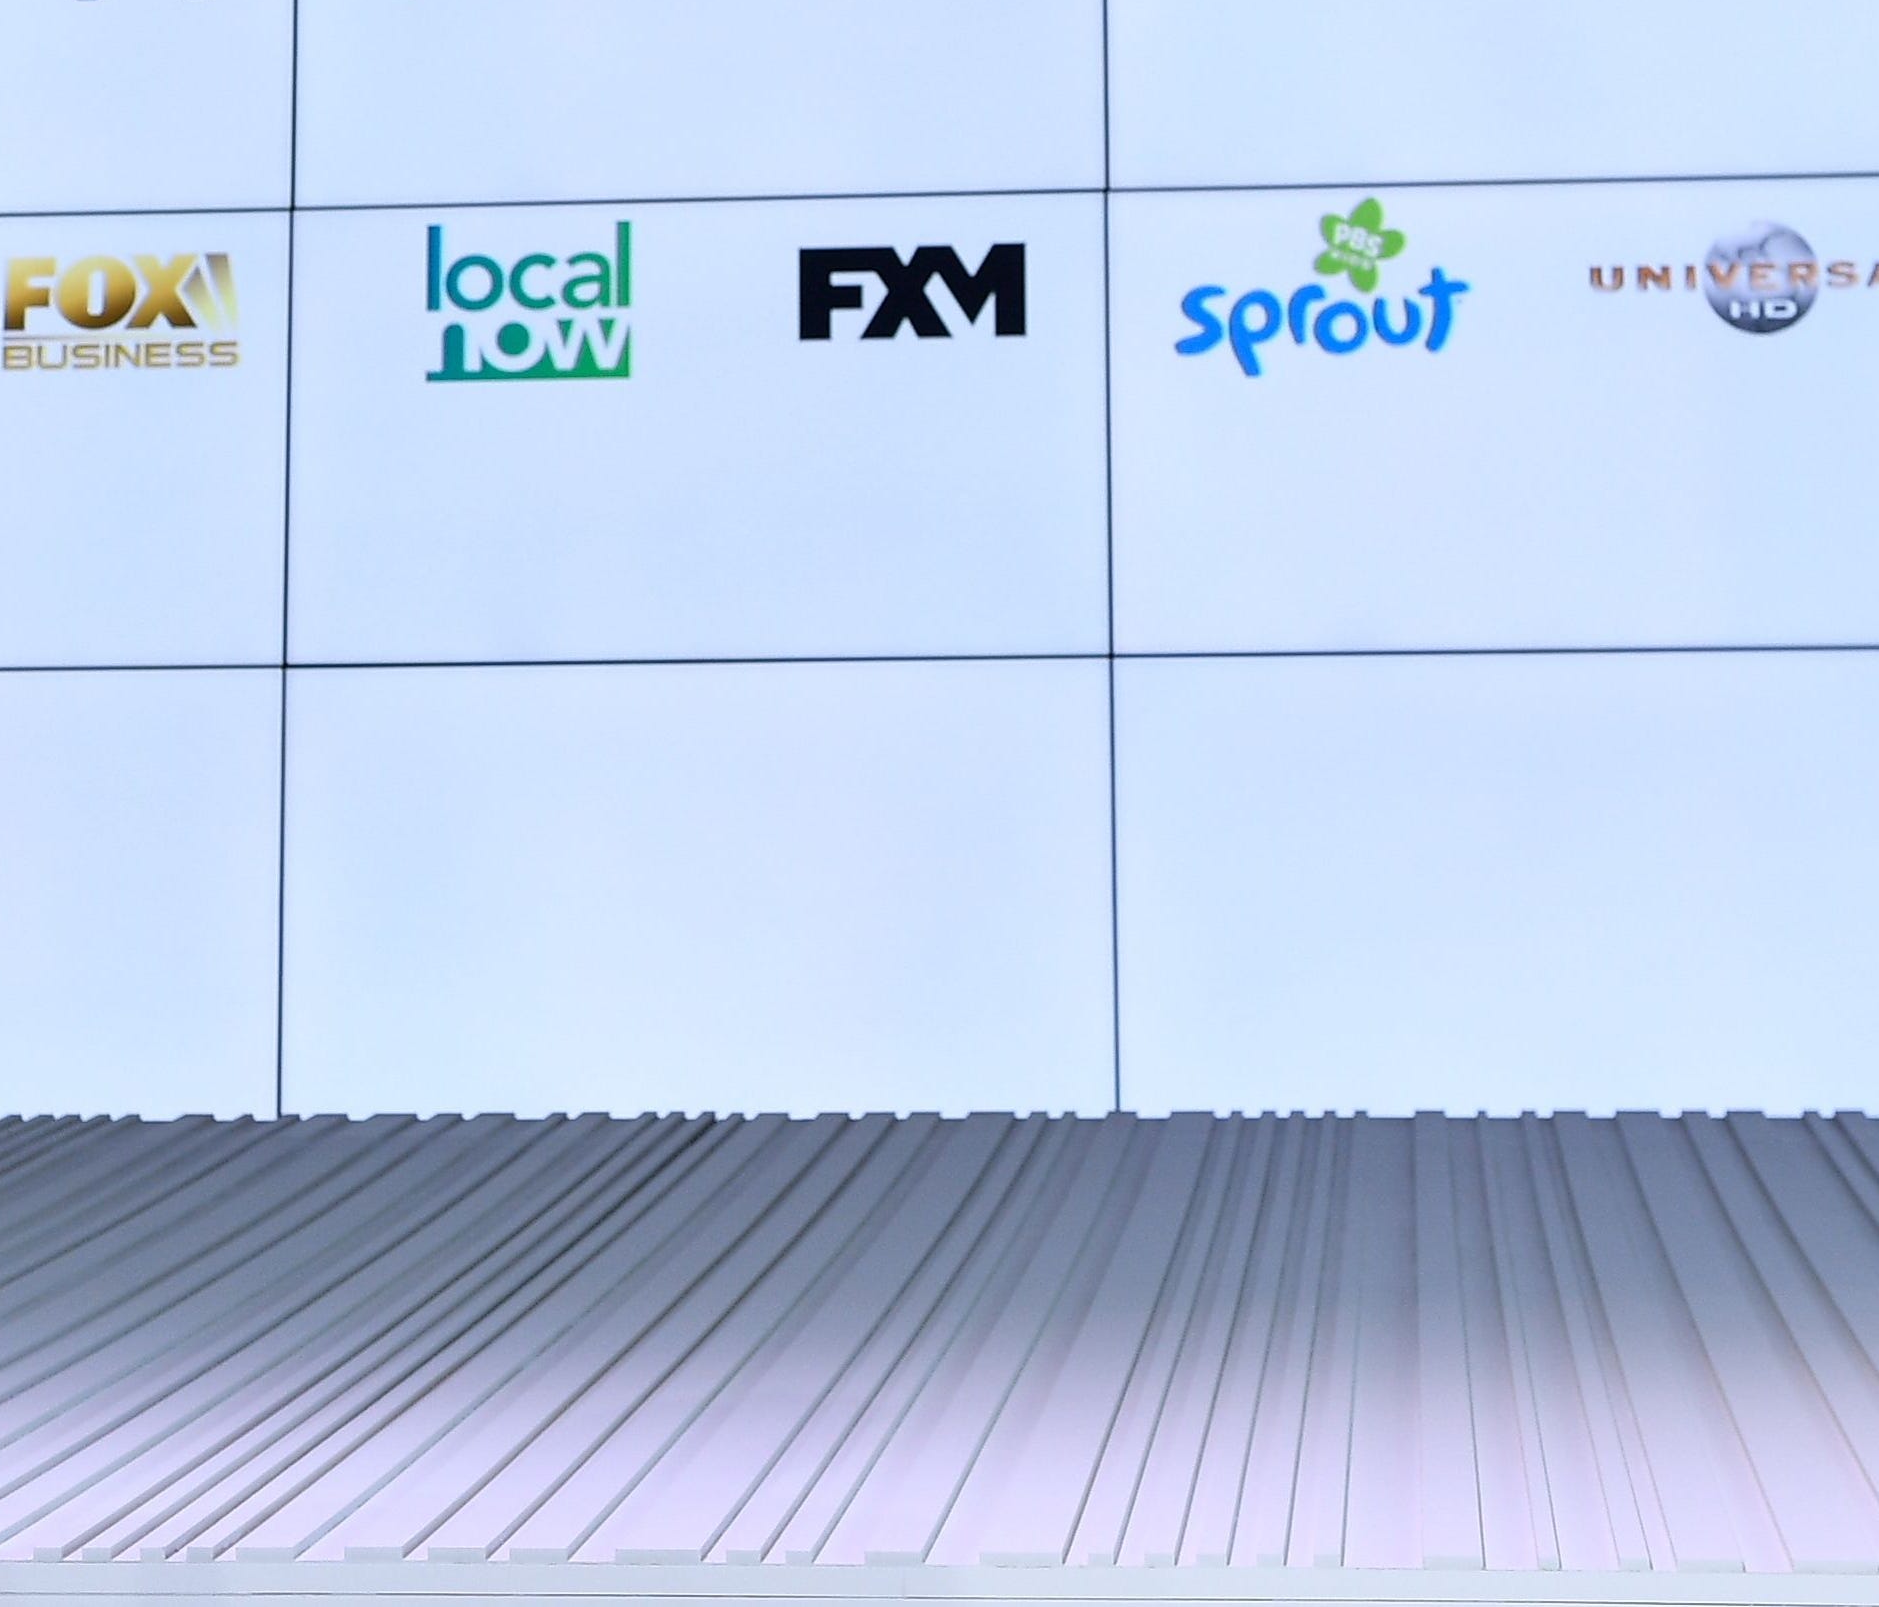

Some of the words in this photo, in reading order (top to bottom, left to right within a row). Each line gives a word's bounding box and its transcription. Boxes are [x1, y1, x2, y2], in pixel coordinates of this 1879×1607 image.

[426, 221, 631, 313] local
[1333, 222, 1384, 258] PBS
[3, 253, 198, 332] FOX
[799, 243, 1026, 341] FXM
[1174, 266, 1472, 378] sprout
[1728, 298, 1799, 321] HD
[3, 340, 239, 371] BUSINESS
[426, 316, 632, 382] now
